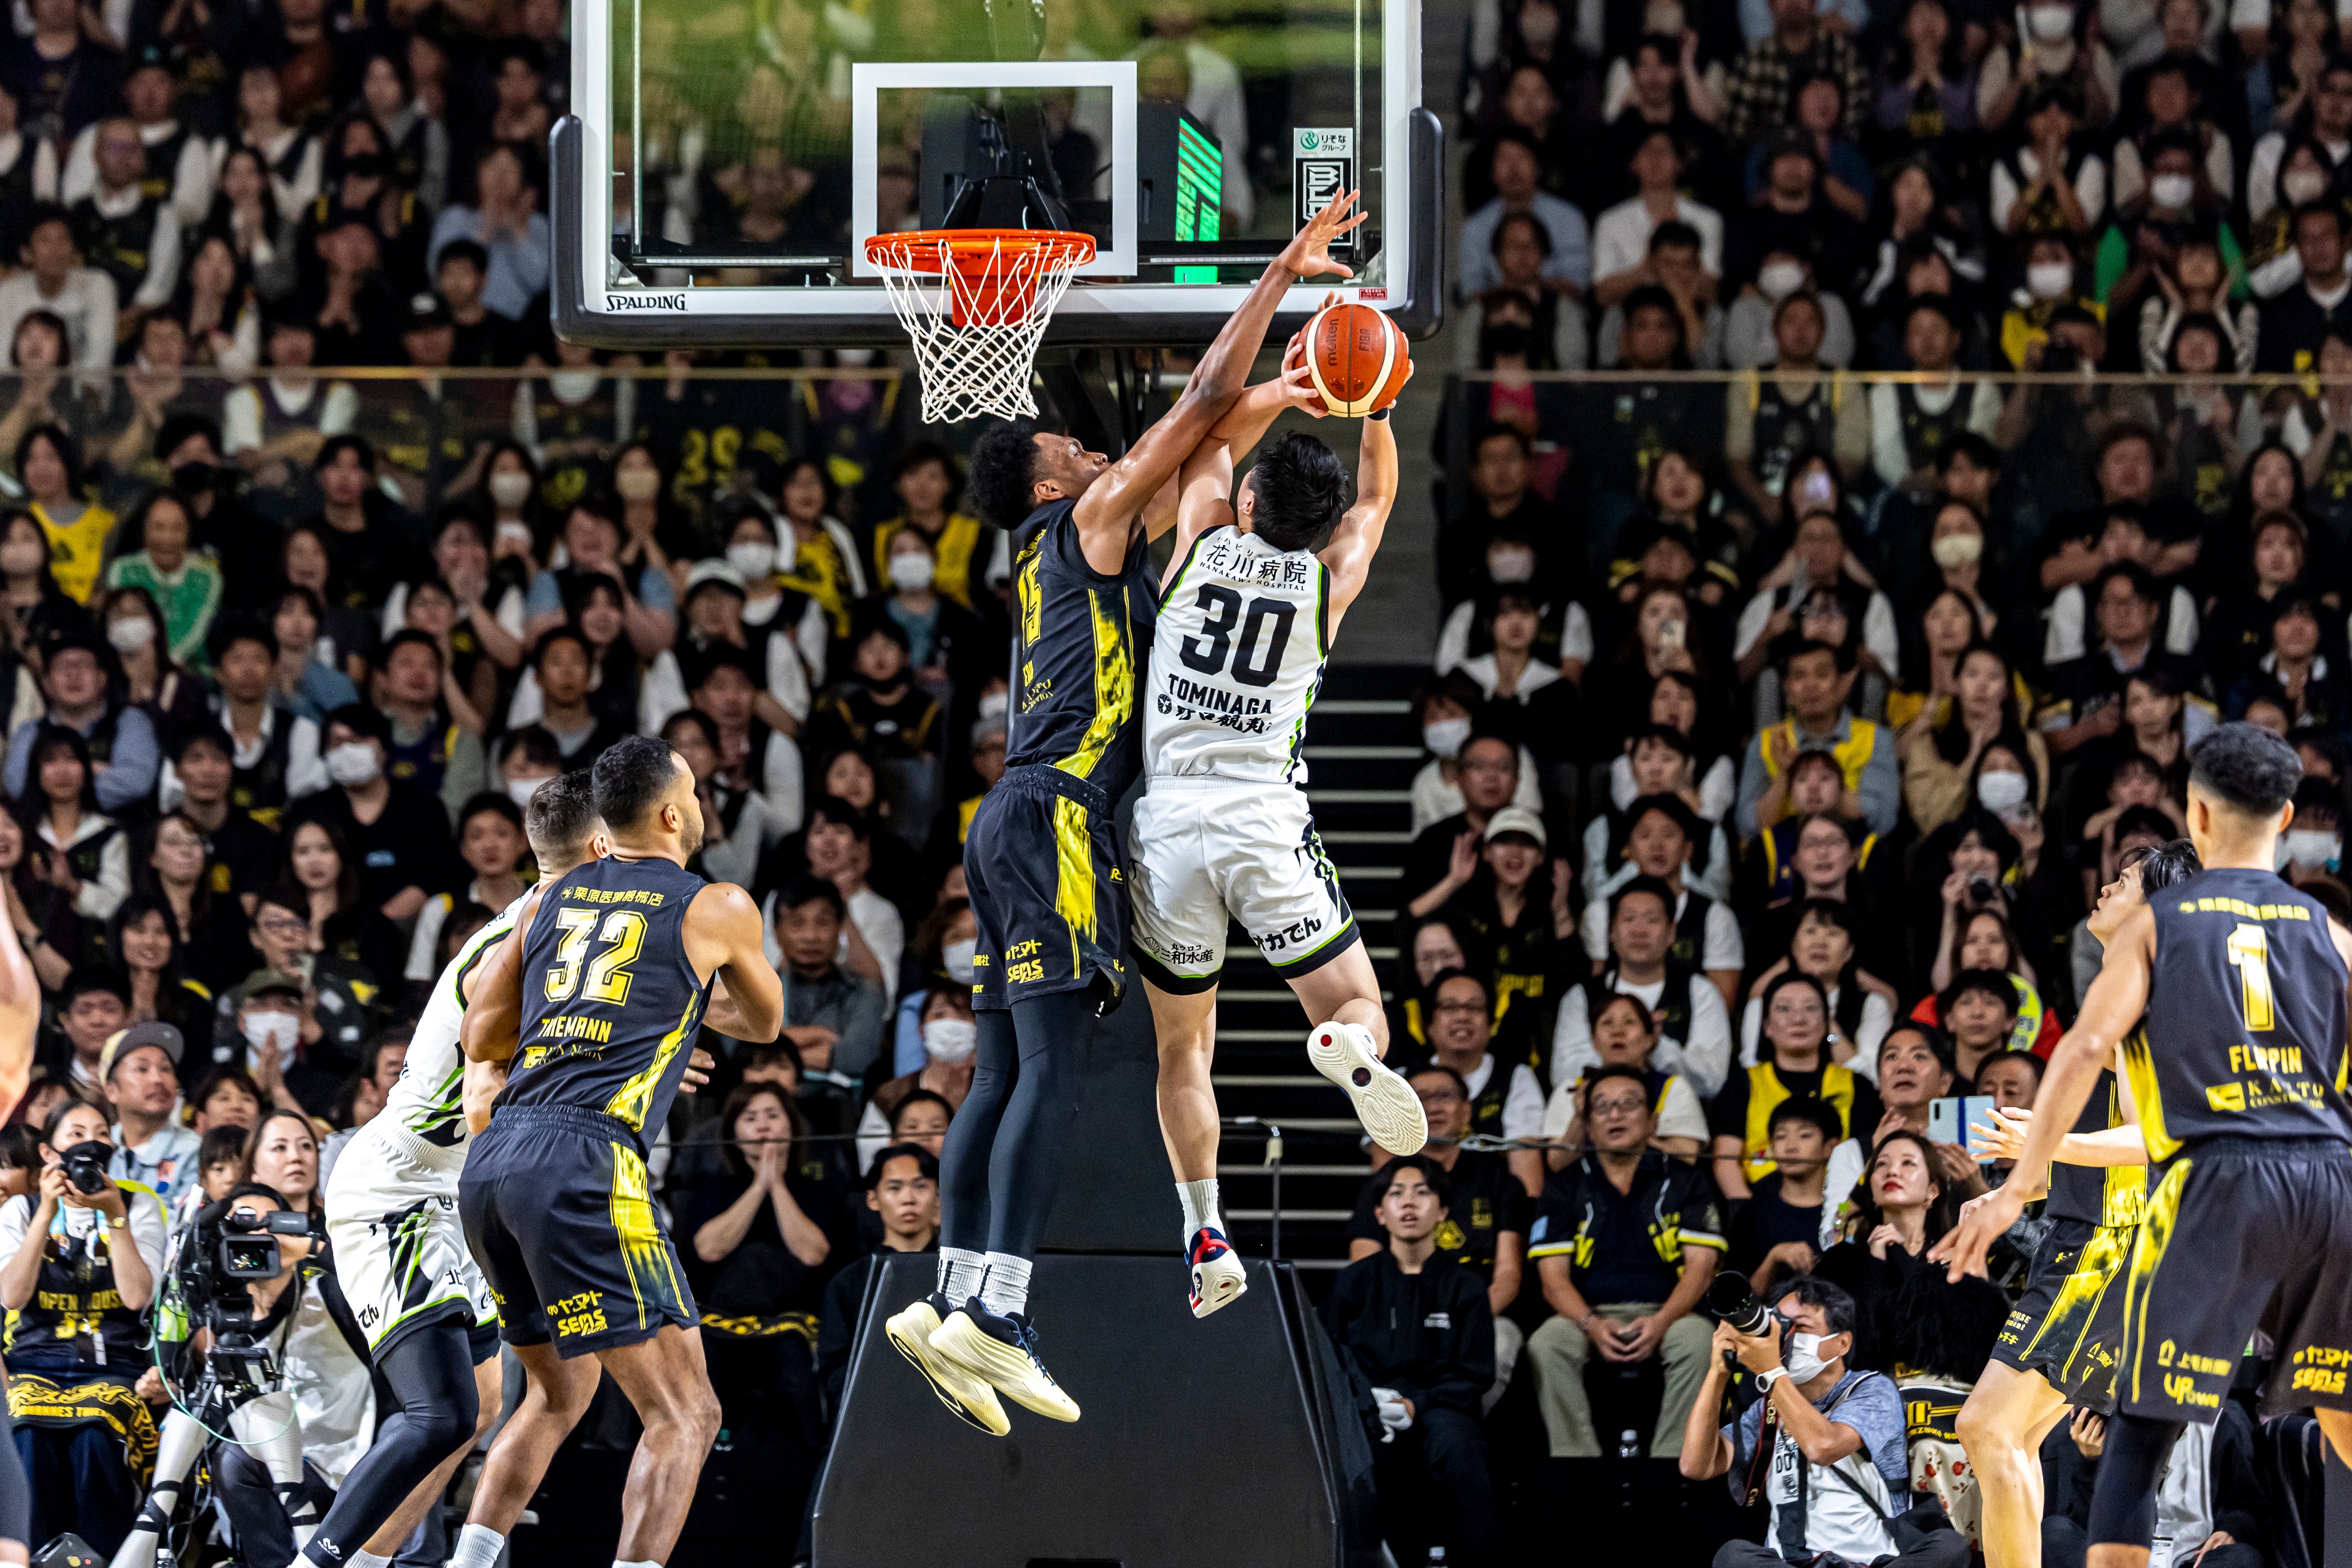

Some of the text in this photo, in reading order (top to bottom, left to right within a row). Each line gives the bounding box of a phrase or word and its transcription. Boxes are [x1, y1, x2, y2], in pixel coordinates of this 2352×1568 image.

[1322, 135, 1347, 144] りそな
[607, 294, 685, 312] SPALDING
[1326, 318, 1339, 366] molten
[1359, 328, 1371, 351] FIBA
[1200, 562, 1305, 591] HANAKAWA HOSPITAL
[1206, 544, 1307, 584] 花川病院
[1179, 583, 1298, 688] 30
[1168, 673, 1272, 715] TOMINAGA
[544, 907, 648, 1007] 32
[1007, 958, 1043, 984] SEMS
[1159, 949, 1214, 964] 三和水産
[2227, 923, 2275, 1031] 1
[558, 1308, 606, 1337] SEMS
